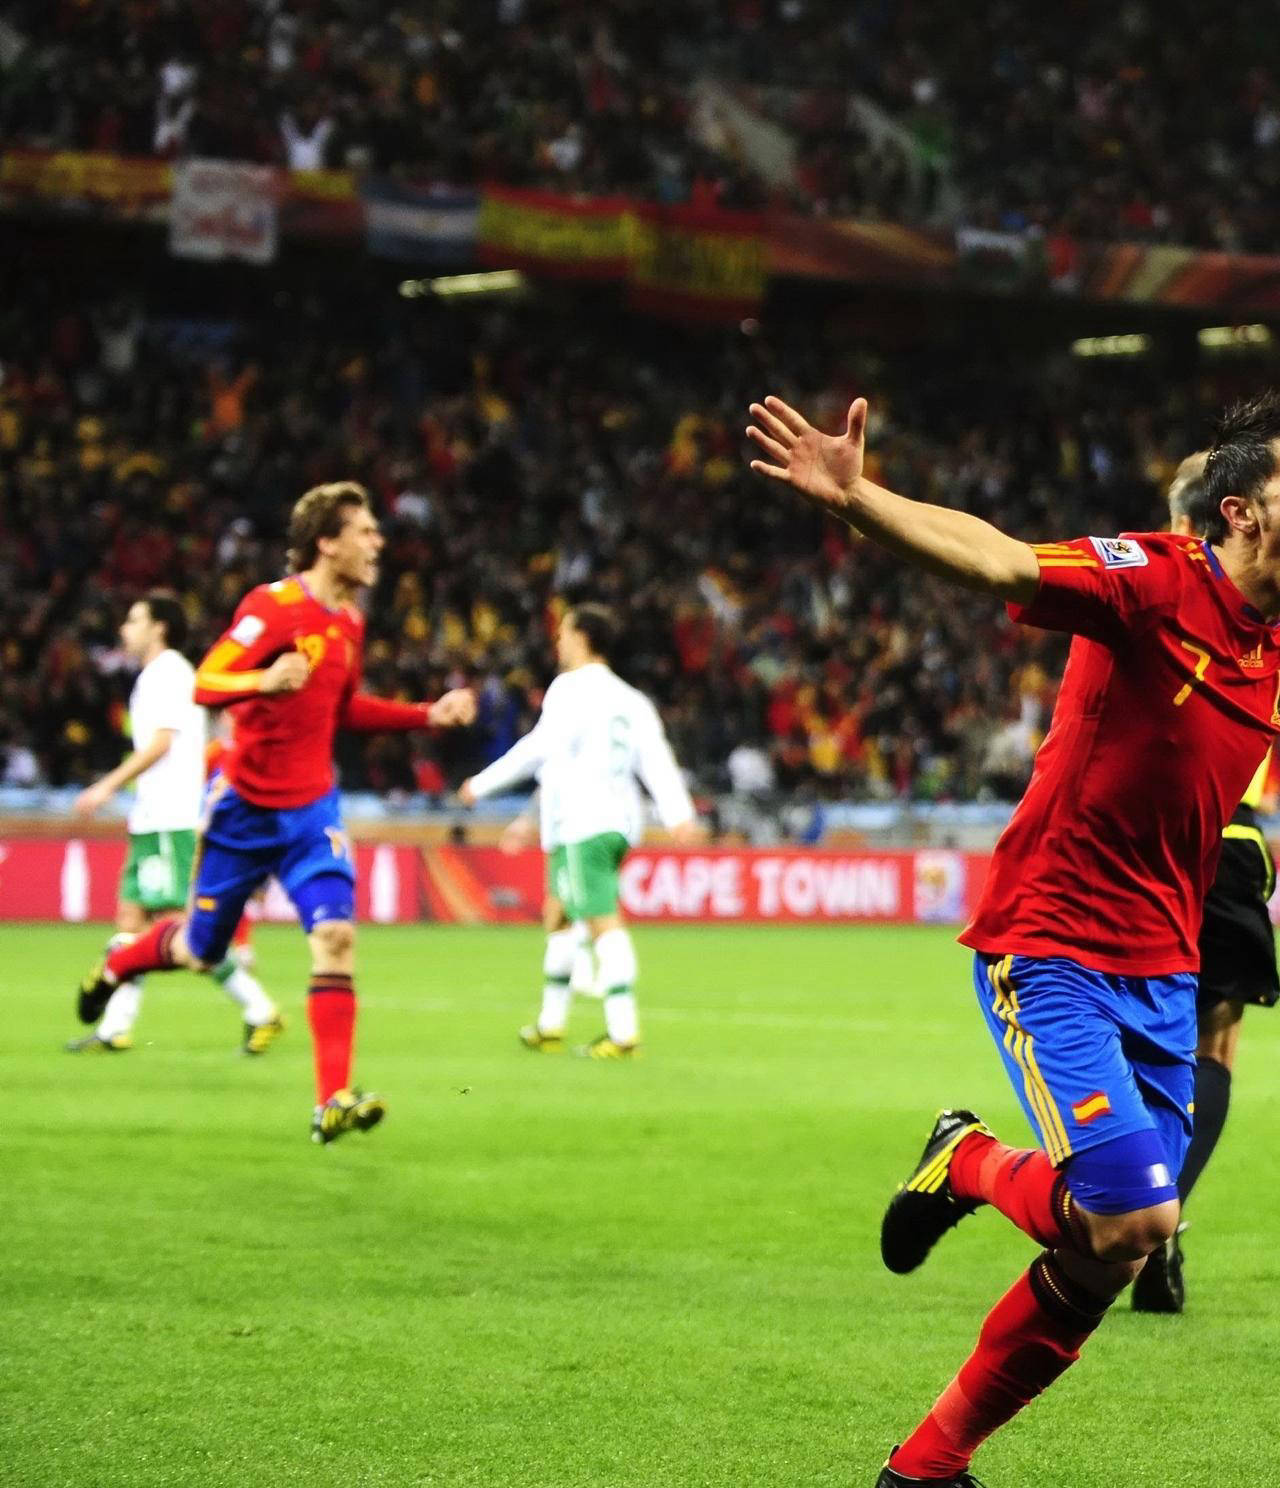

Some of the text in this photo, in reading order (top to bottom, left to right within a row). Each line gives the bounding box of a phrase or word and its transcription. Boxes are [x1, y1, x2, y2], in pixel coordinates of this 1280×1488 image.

[1173, 639, 1212, 706] 7
[619, 855, 899, 917] CAPE TOWN
